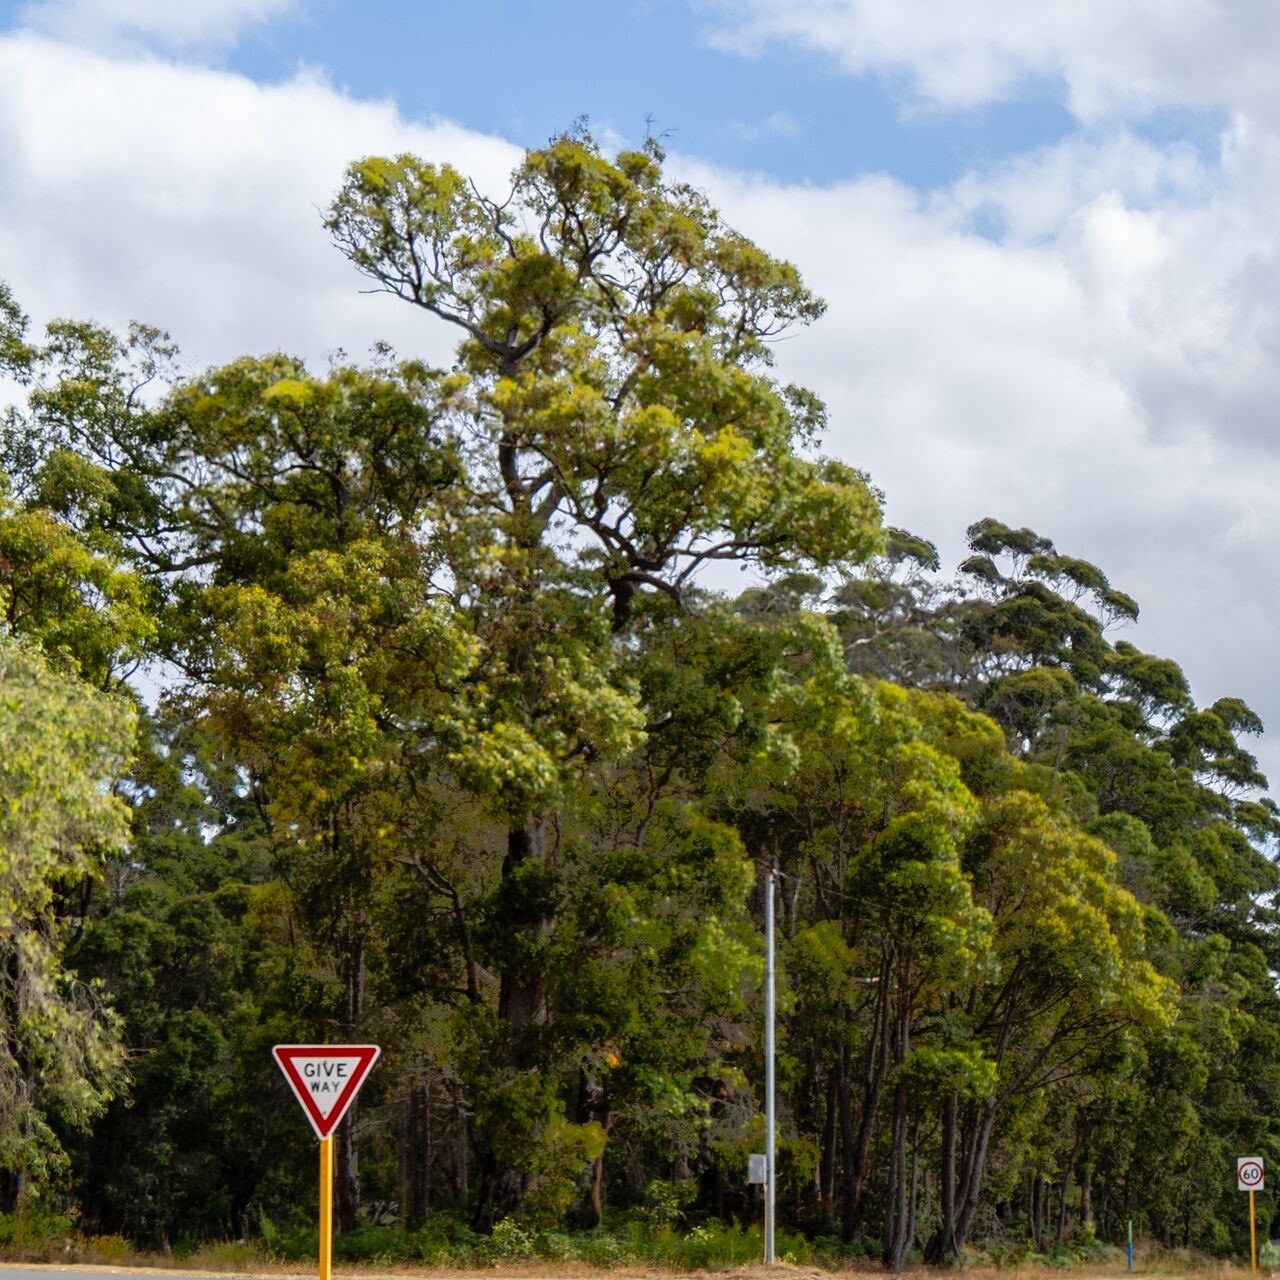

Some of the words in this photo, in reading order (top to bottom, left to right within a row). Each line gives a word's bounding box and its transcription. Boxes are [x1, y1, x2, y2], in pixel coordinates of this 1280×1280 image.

[304, 1063, 347, 1077] GIVE
[310, 1081, 340, 1093] WAY
[1243, 1168, 1259, 1180] 60
